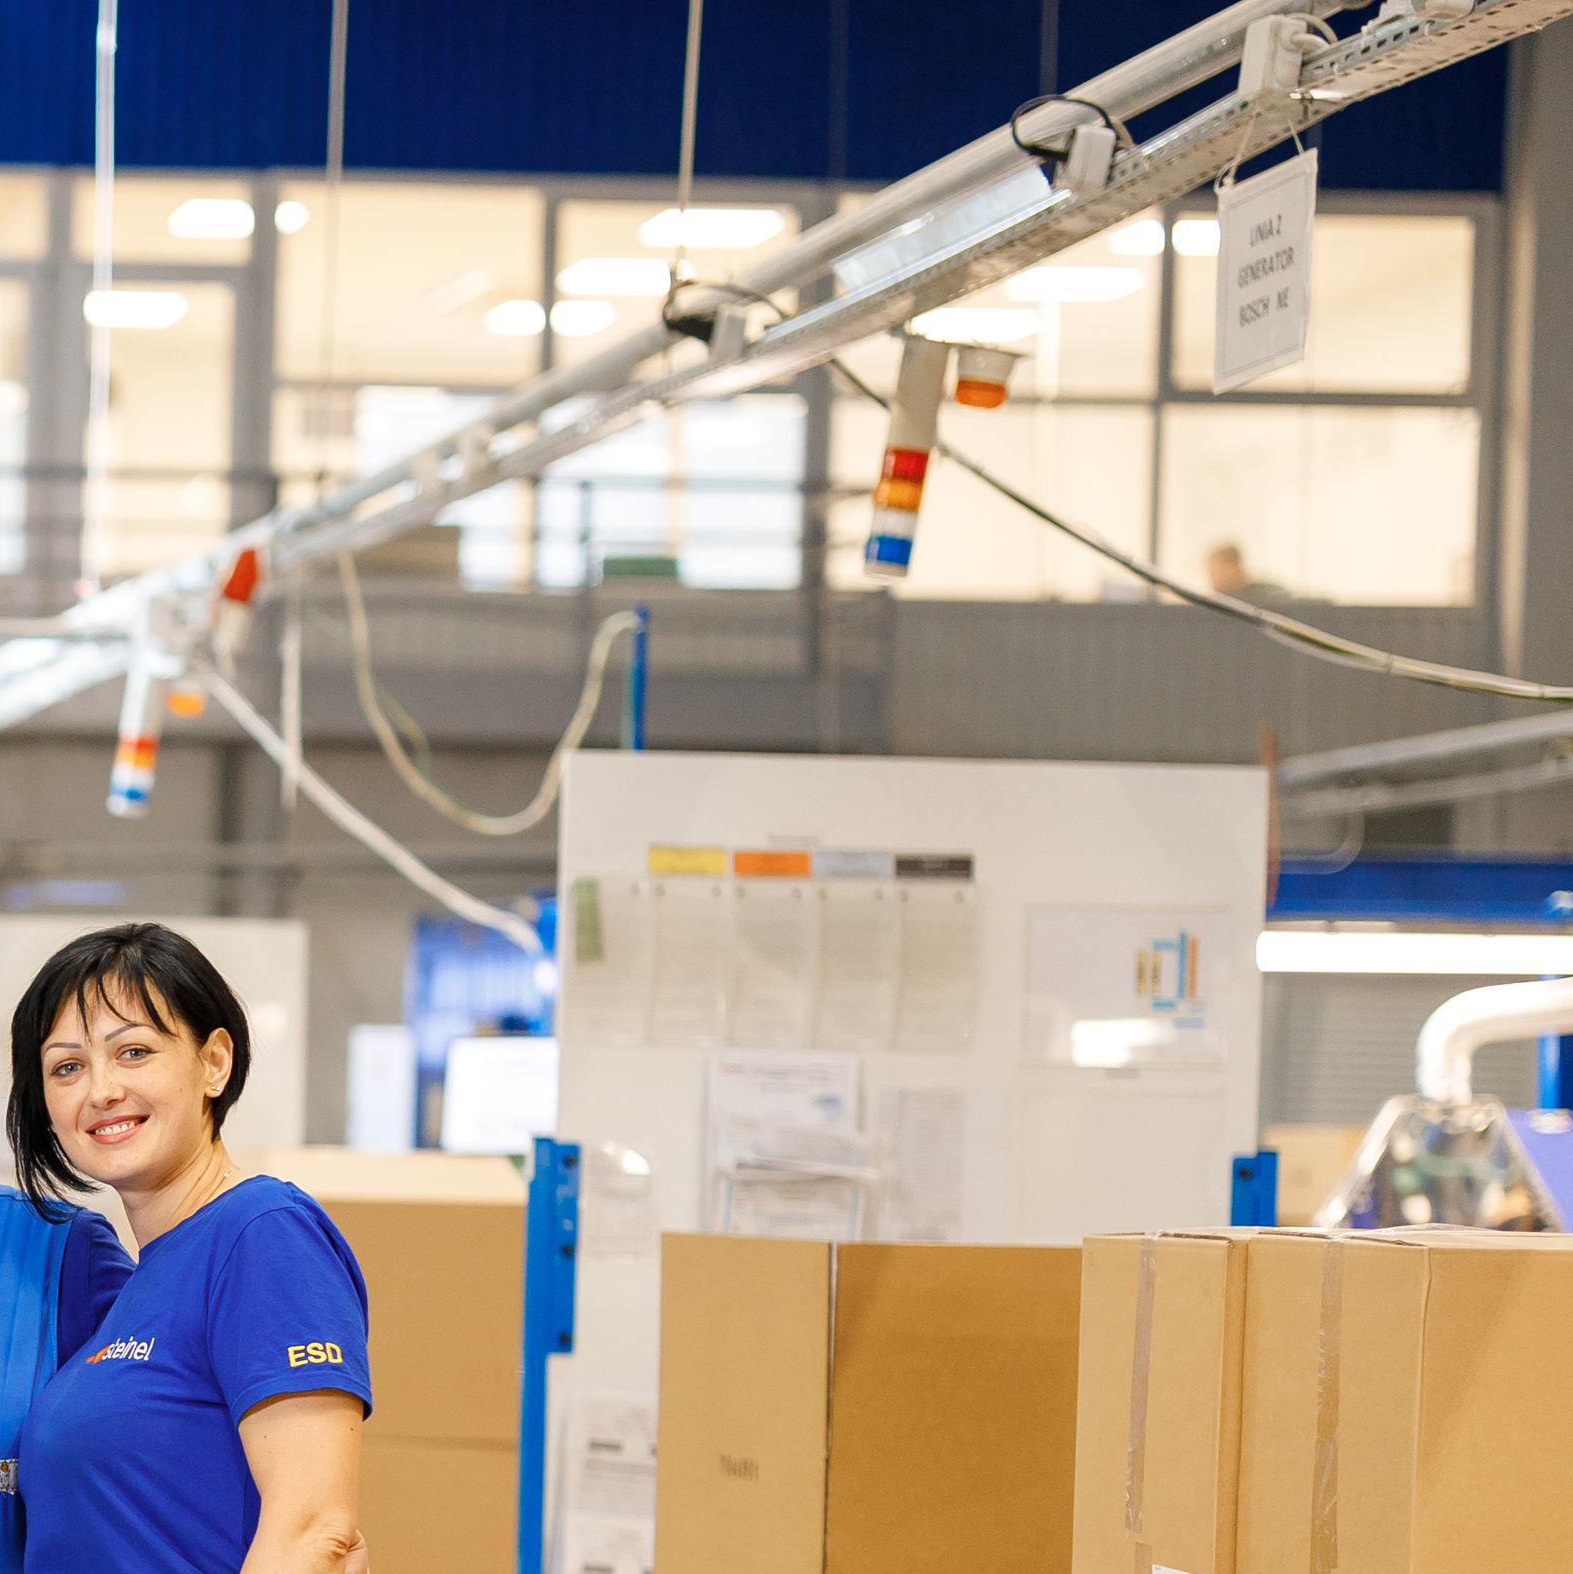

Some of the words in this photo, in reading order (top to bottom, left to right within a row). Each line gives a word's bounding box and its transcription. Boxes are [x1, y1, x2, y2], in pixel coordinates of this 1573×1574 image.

[1237, 246, 1294, 289] GENERATOR
[101, 1336, 155, 1361] steinel
[287, 1342, 343, 1368] ESD
